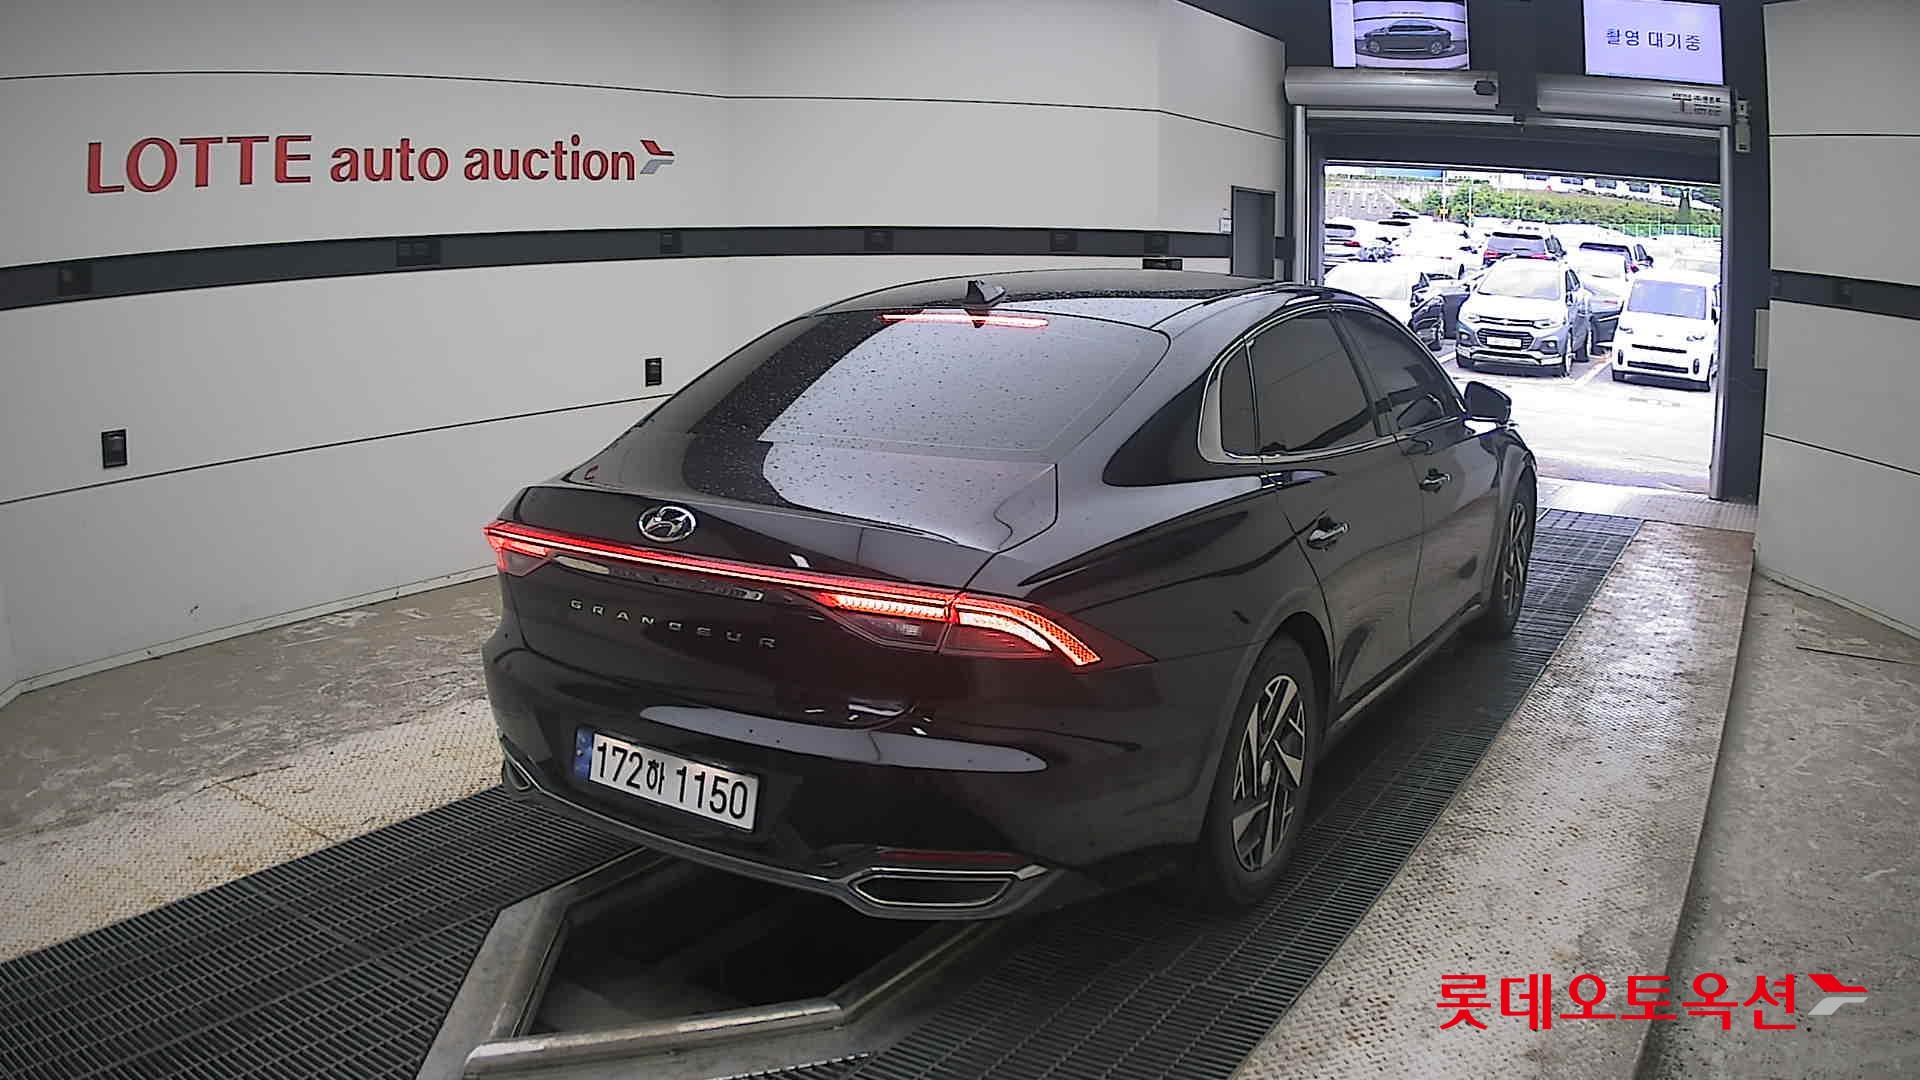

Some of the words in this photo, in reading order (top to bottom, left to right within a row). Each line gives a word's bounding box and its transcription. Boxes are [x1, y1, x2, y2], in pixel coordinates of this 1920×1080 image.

[1647, 31, 1701, 51] 대기중
[87, 135, 312, 194] LOTTE
[330, 138, 449, 183] auto
[464, 134, 635, 181] auction
[570, 600, 776, 648] GRANDEUR
[597, 742, 664, 795] 172하
[677, 767, 748, 820] 1150
